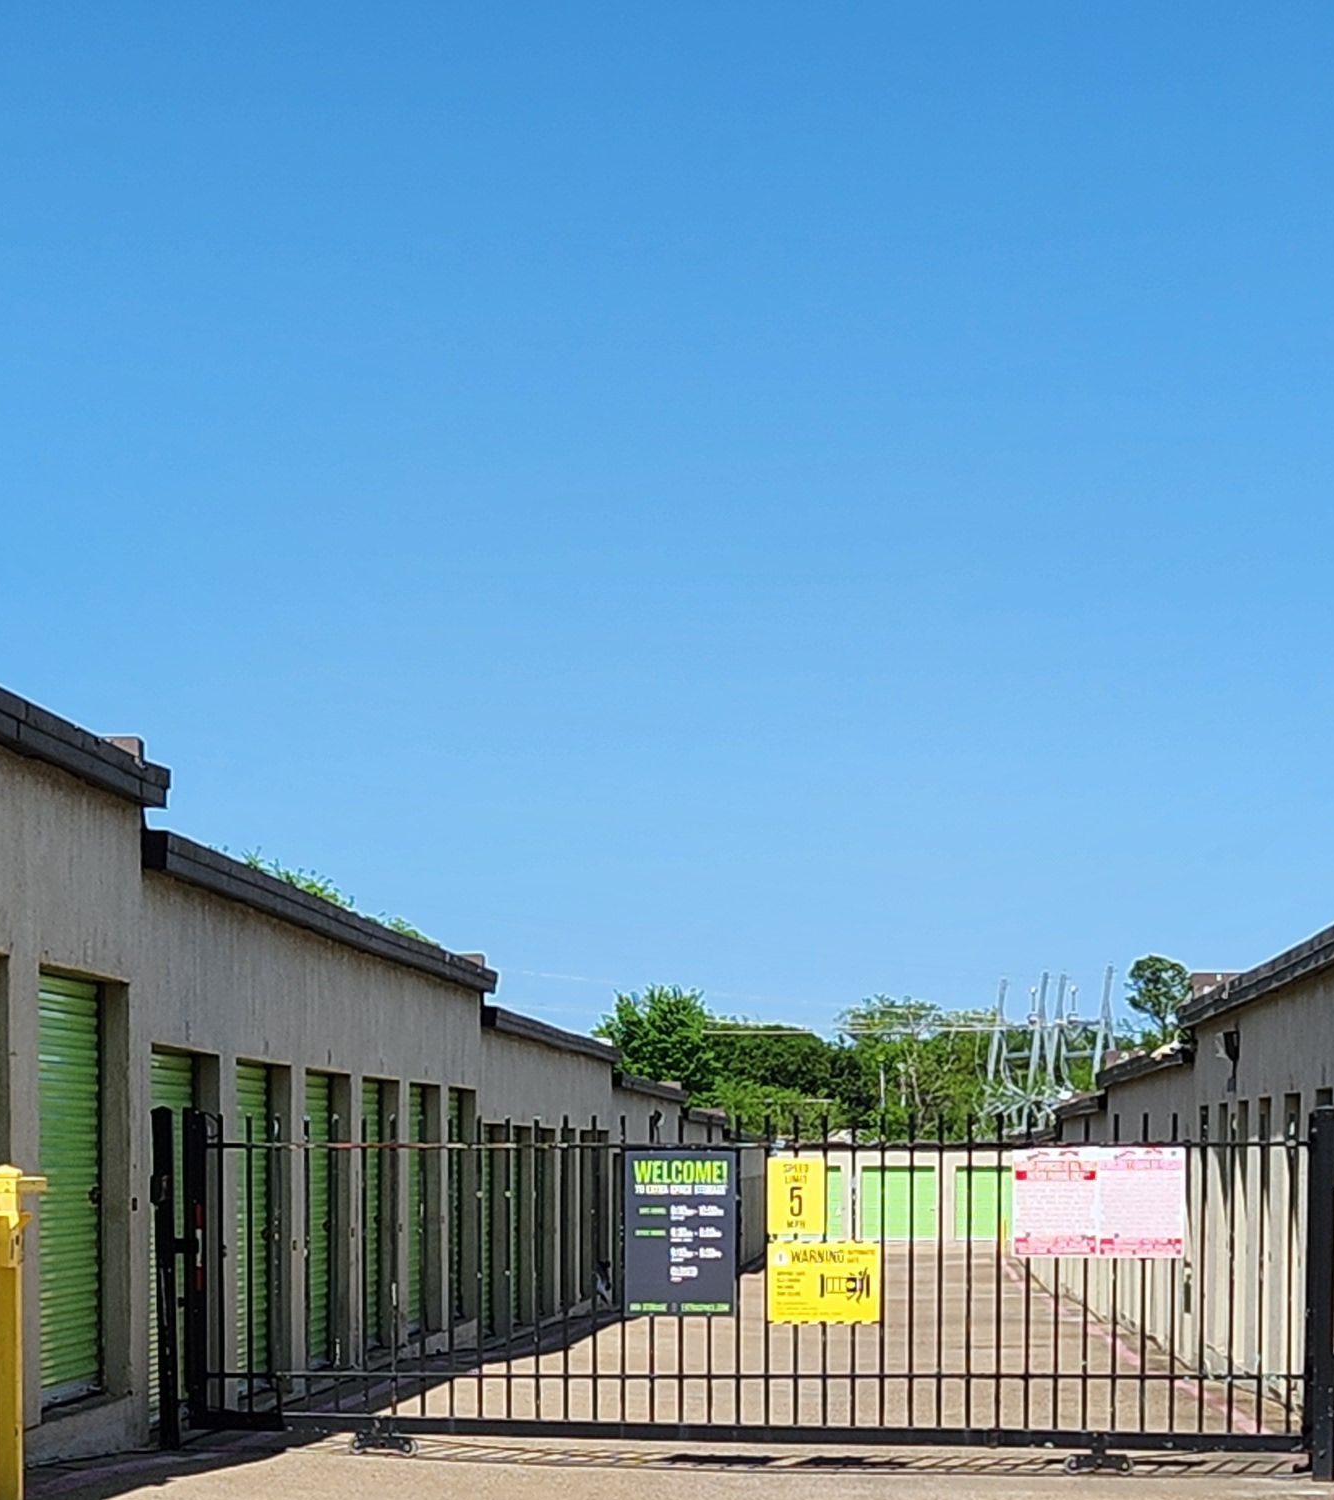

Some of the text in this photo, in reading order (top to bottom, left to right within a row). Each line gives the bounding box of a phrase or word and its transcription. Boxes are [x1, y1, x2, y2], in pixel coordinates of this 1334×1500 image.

[633, 1160, 728, 1184] WELCOME!
[790, 1186, 803, 1217] 5
[790, 1249, 845, 1264] WARNING
